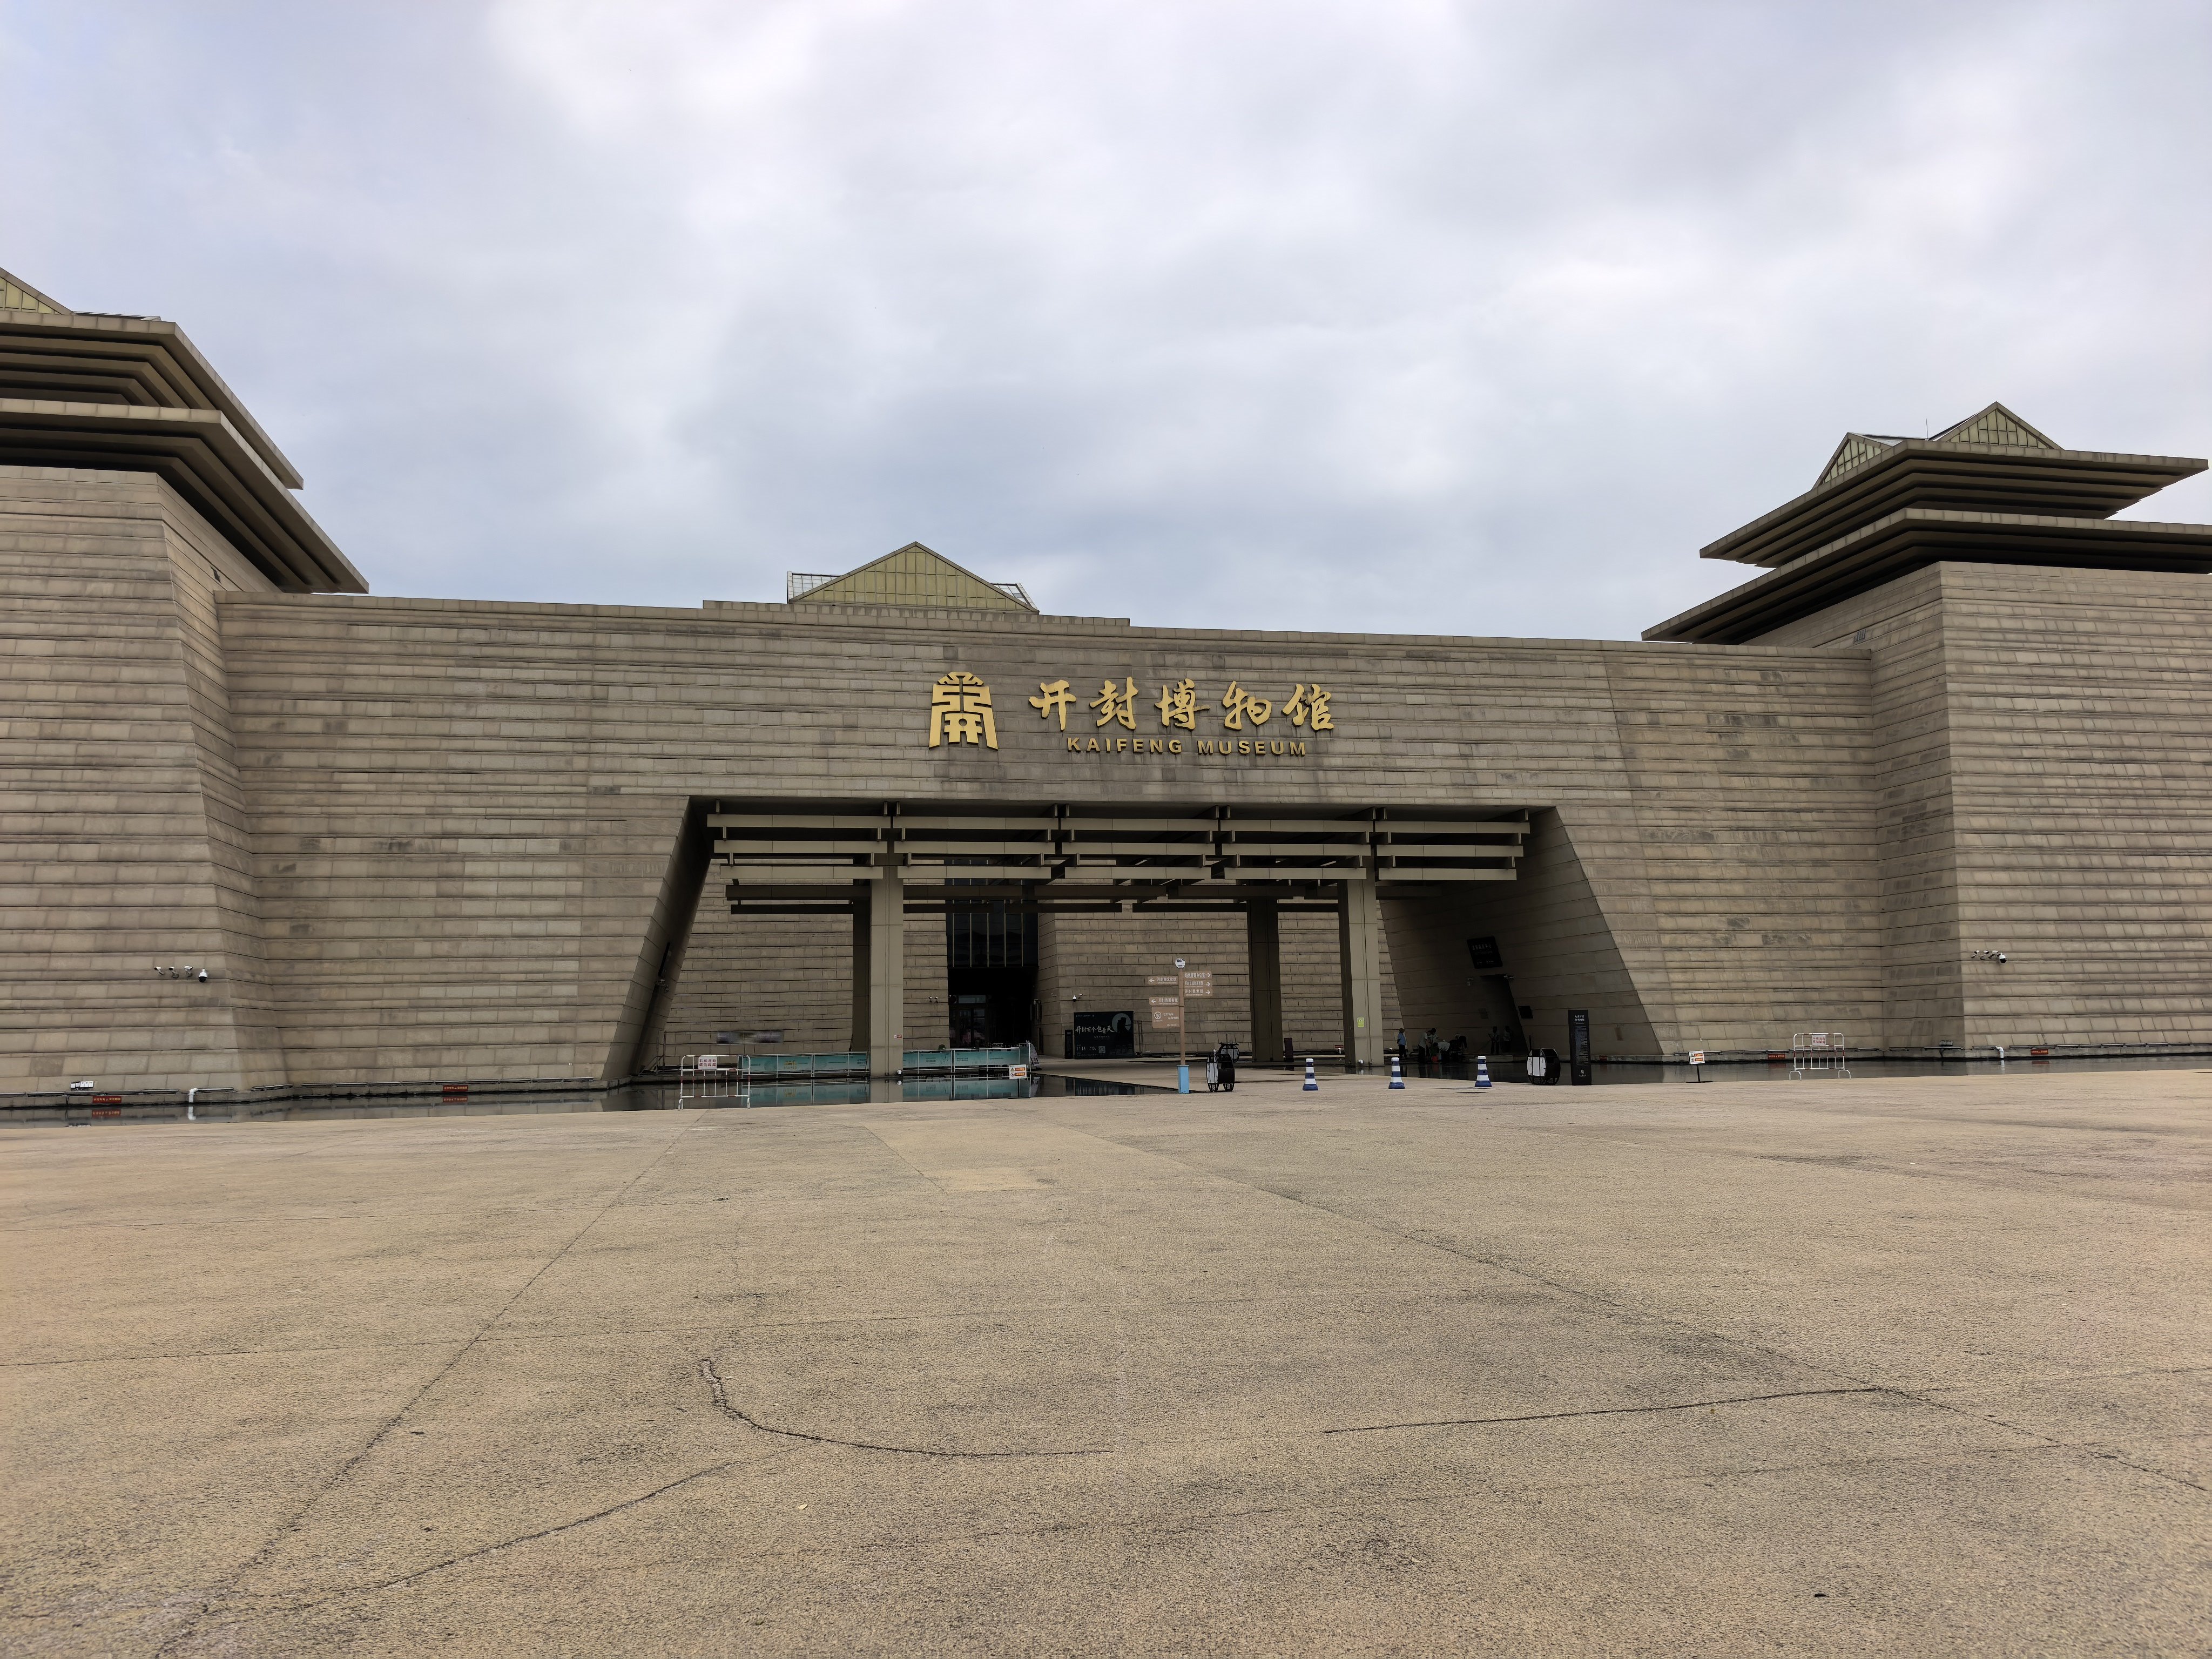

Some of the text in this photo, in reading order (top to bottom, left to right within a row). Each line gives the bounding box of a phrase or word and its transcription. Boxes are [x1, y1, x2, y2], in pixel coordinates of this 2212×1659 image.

[1029, 676, 1335, 732] 开封博物馆
[1067, 737, 1306, 756] KAIFENG MUSEUM
